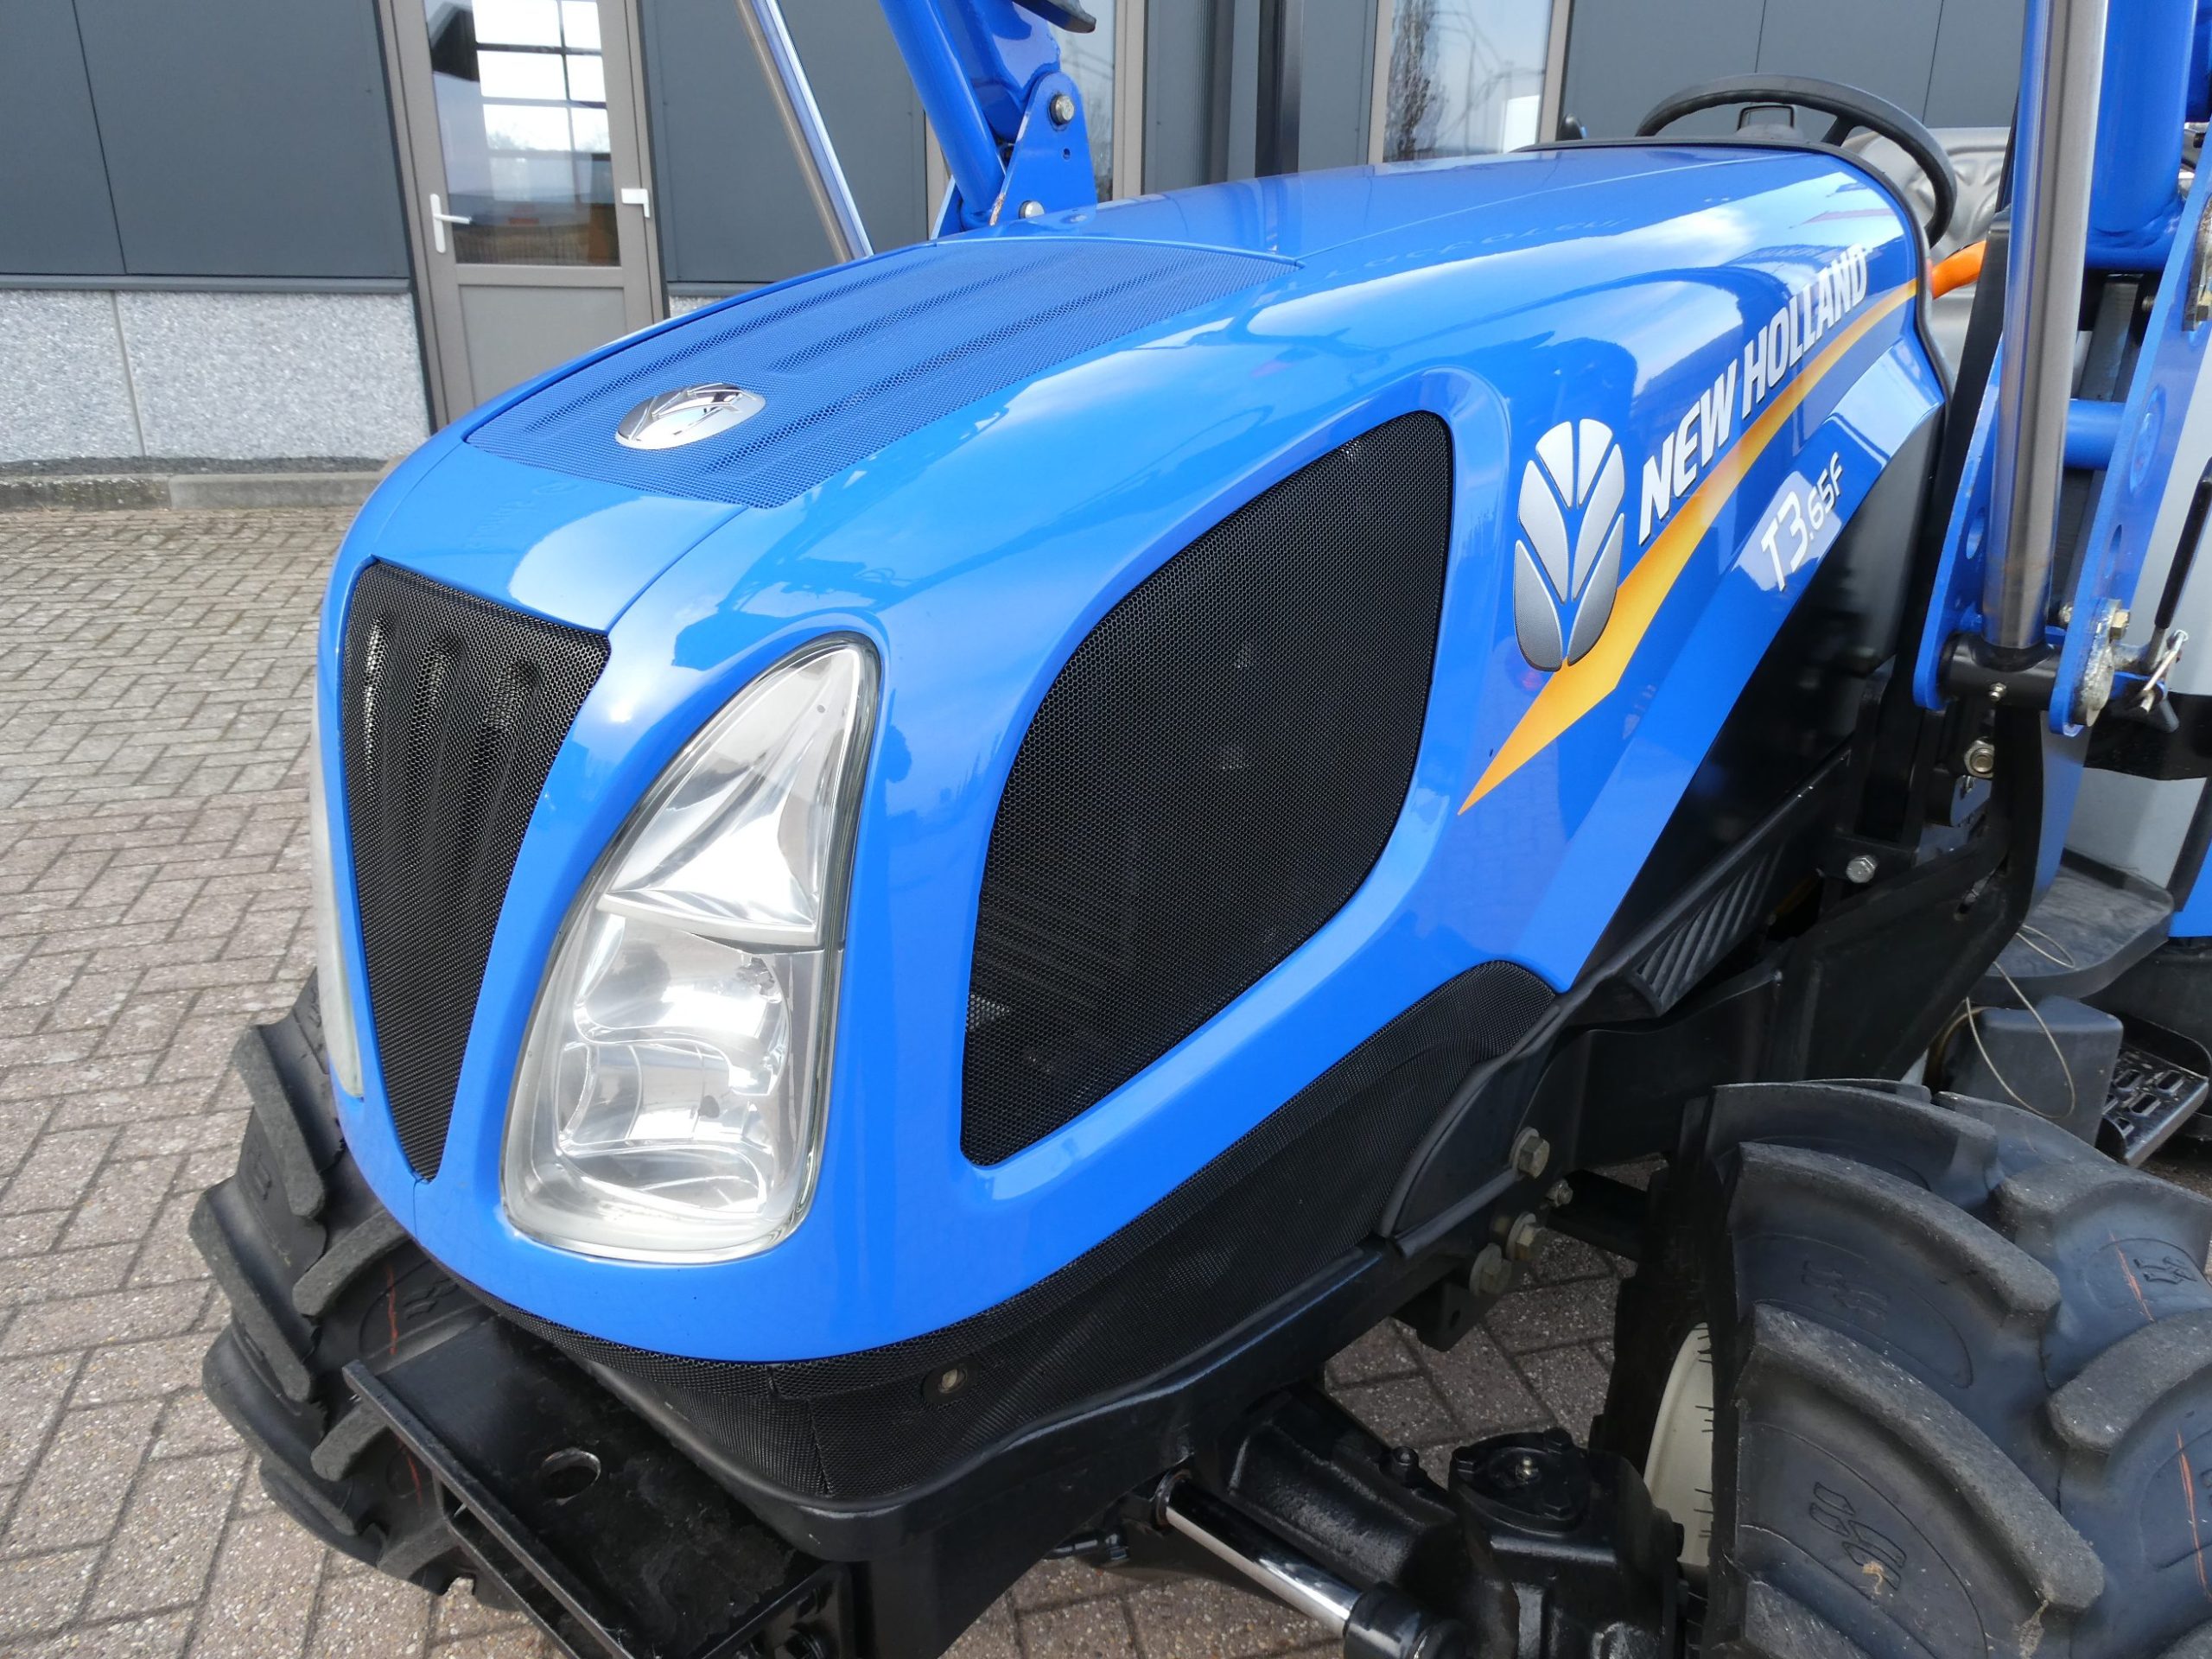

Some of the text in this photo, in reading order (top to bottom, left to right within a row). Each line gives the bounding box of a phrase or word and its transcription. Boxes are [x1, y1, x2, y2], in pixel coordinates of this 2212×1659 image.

[1639, 244, 1867, 546] NEW HOLLAND
[1761, 452, 1842, 592] T3.65F
